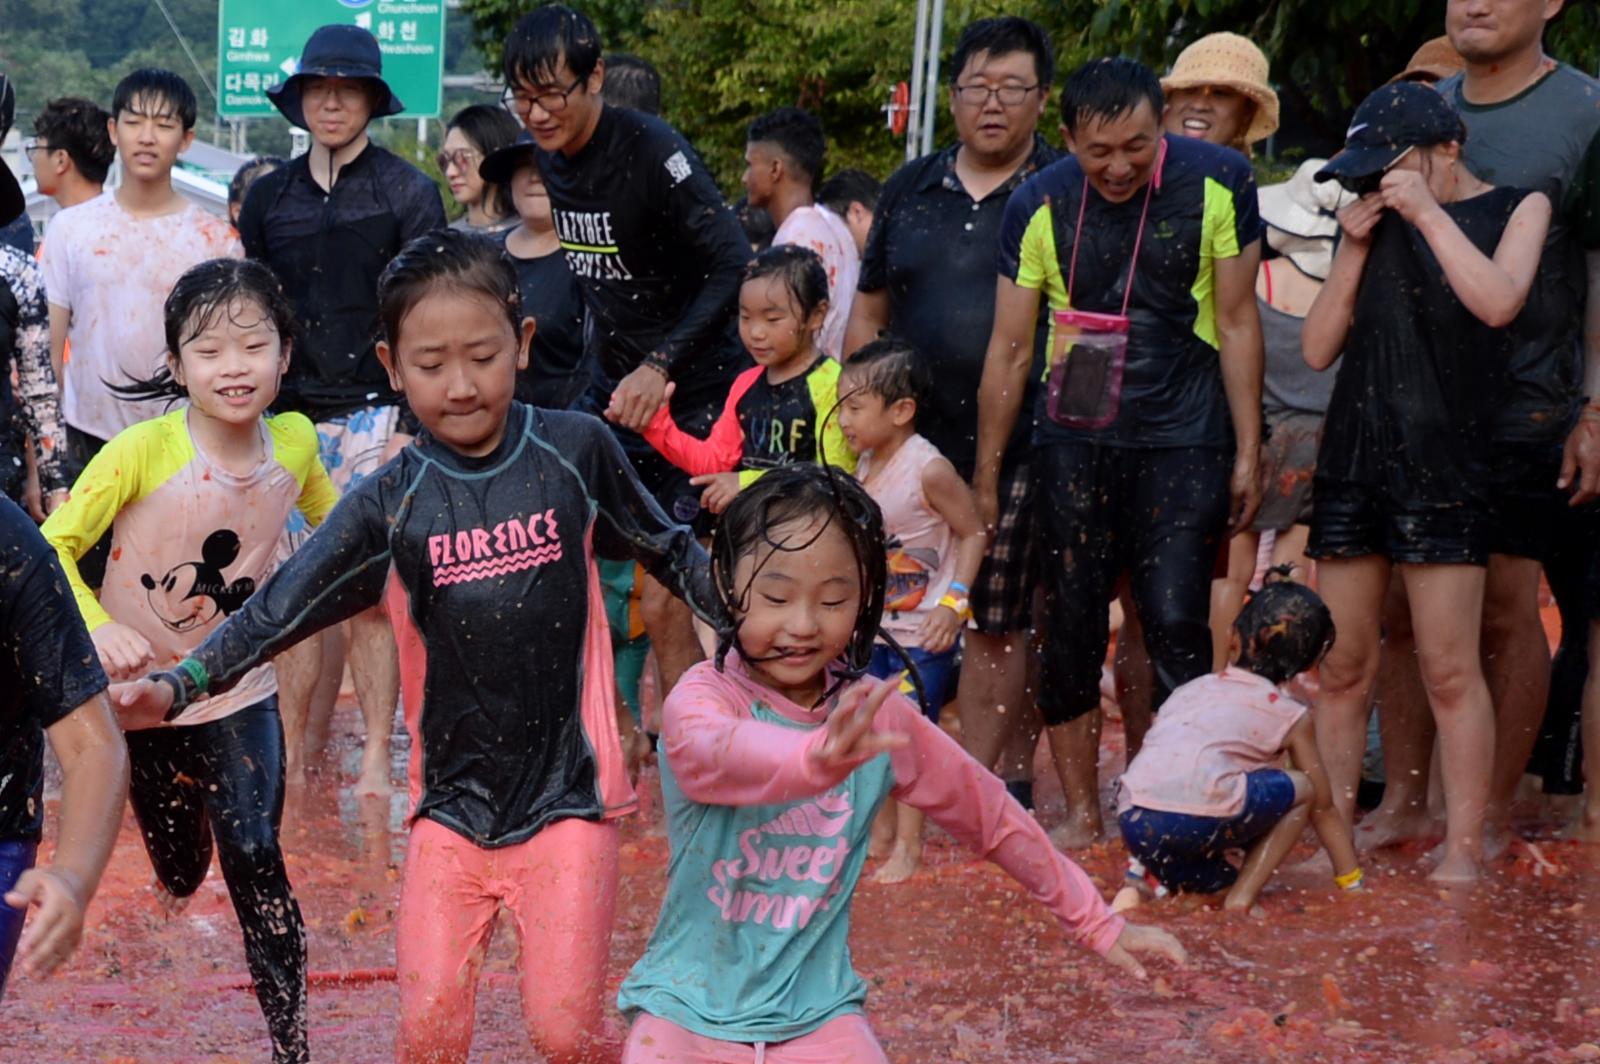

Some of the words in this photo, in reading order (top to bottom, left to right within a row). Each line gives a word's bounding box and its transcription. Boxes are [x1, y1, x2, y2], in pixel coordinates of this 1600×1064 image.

[377, 3, 438, 14] Chuncheon
[227, 51, 270, 62] Gimhwa
[429, 508, 560, 567] FLORENCE
[195, 582, 243, 595] MICKEY
[726, 828, 851, 884] Sweet
[707, 859, 832, 930] Summ
